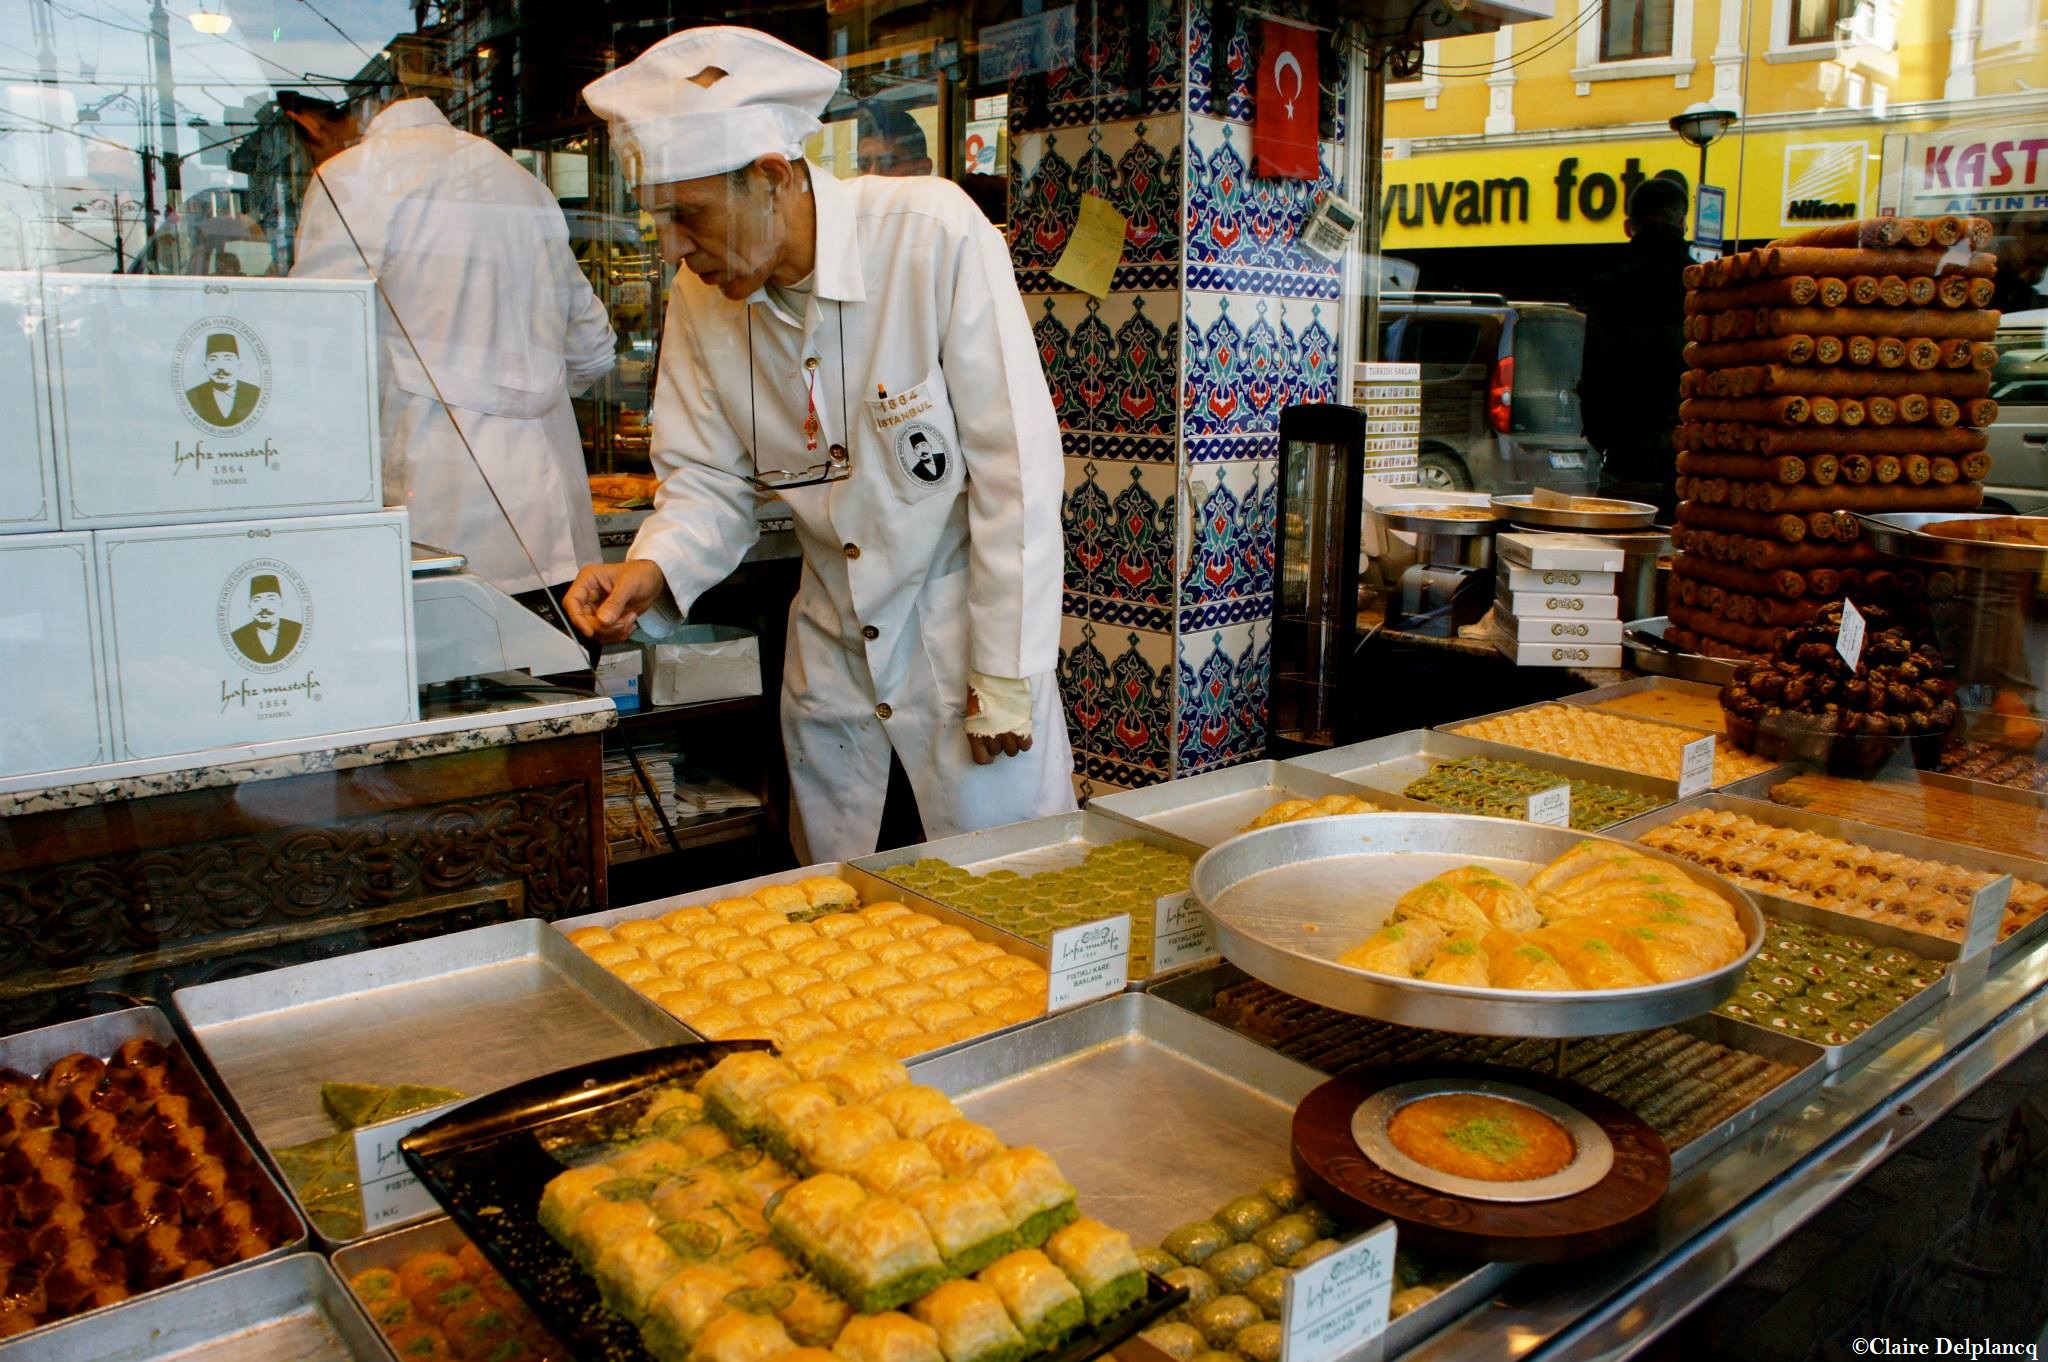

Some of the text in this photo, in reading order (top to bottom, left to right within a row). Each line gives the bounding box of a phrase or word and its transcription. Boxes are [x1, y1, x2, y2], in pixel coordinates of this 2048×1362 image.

[1787, 199, 1857, 220] Nikon
[1944, 197, 2024, 212] ALTIN
[880, 390, 918, 412] 1864
[214, 465, 244, 474] 1864
[1092, 963, 1110, 972] KARE
[383, 1206, 399, 1217] KG
